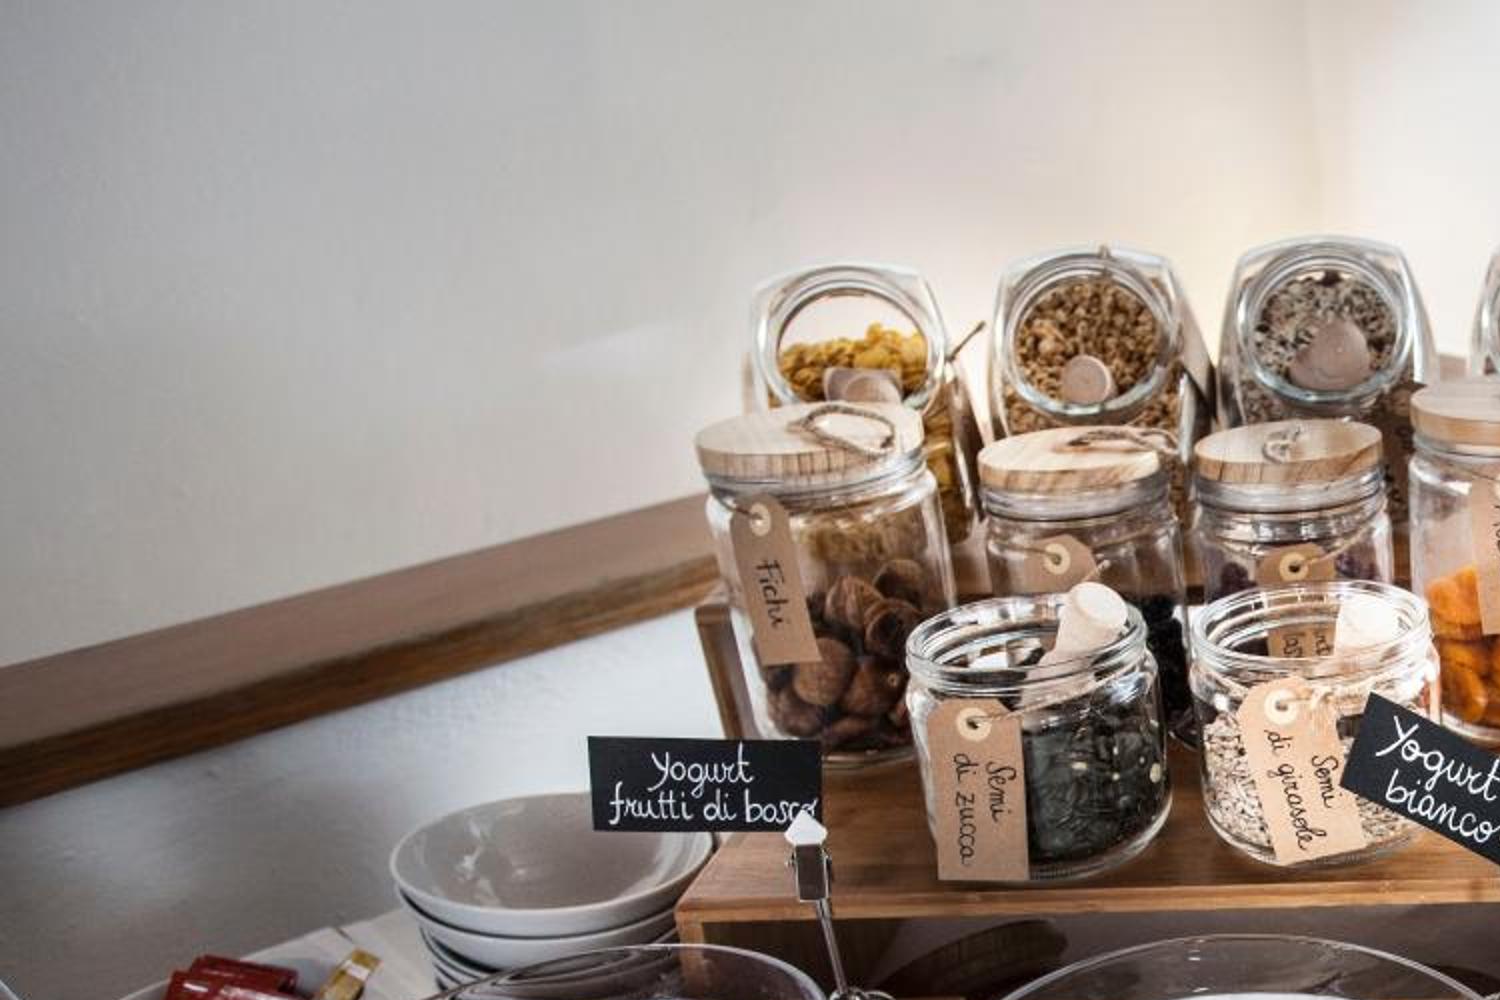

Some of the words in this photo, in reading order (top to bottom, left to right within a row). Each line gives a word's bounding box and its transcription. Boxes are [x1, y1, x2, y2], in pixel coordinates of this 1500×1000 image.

[756, 559, 792, 629] Fichi
[647, 741, 754, 799] Yogurt
[954, 753, 979, 784] di
[1263, 729, 1295, 755] di
[608, 781, 694, 825] frutti
[703, 788, 737, 821] di
[986, 761, 1017, 823] Semi
[1266, 763, 1327, 851] girasole
[1311, 755, 1343, 809] Semi
